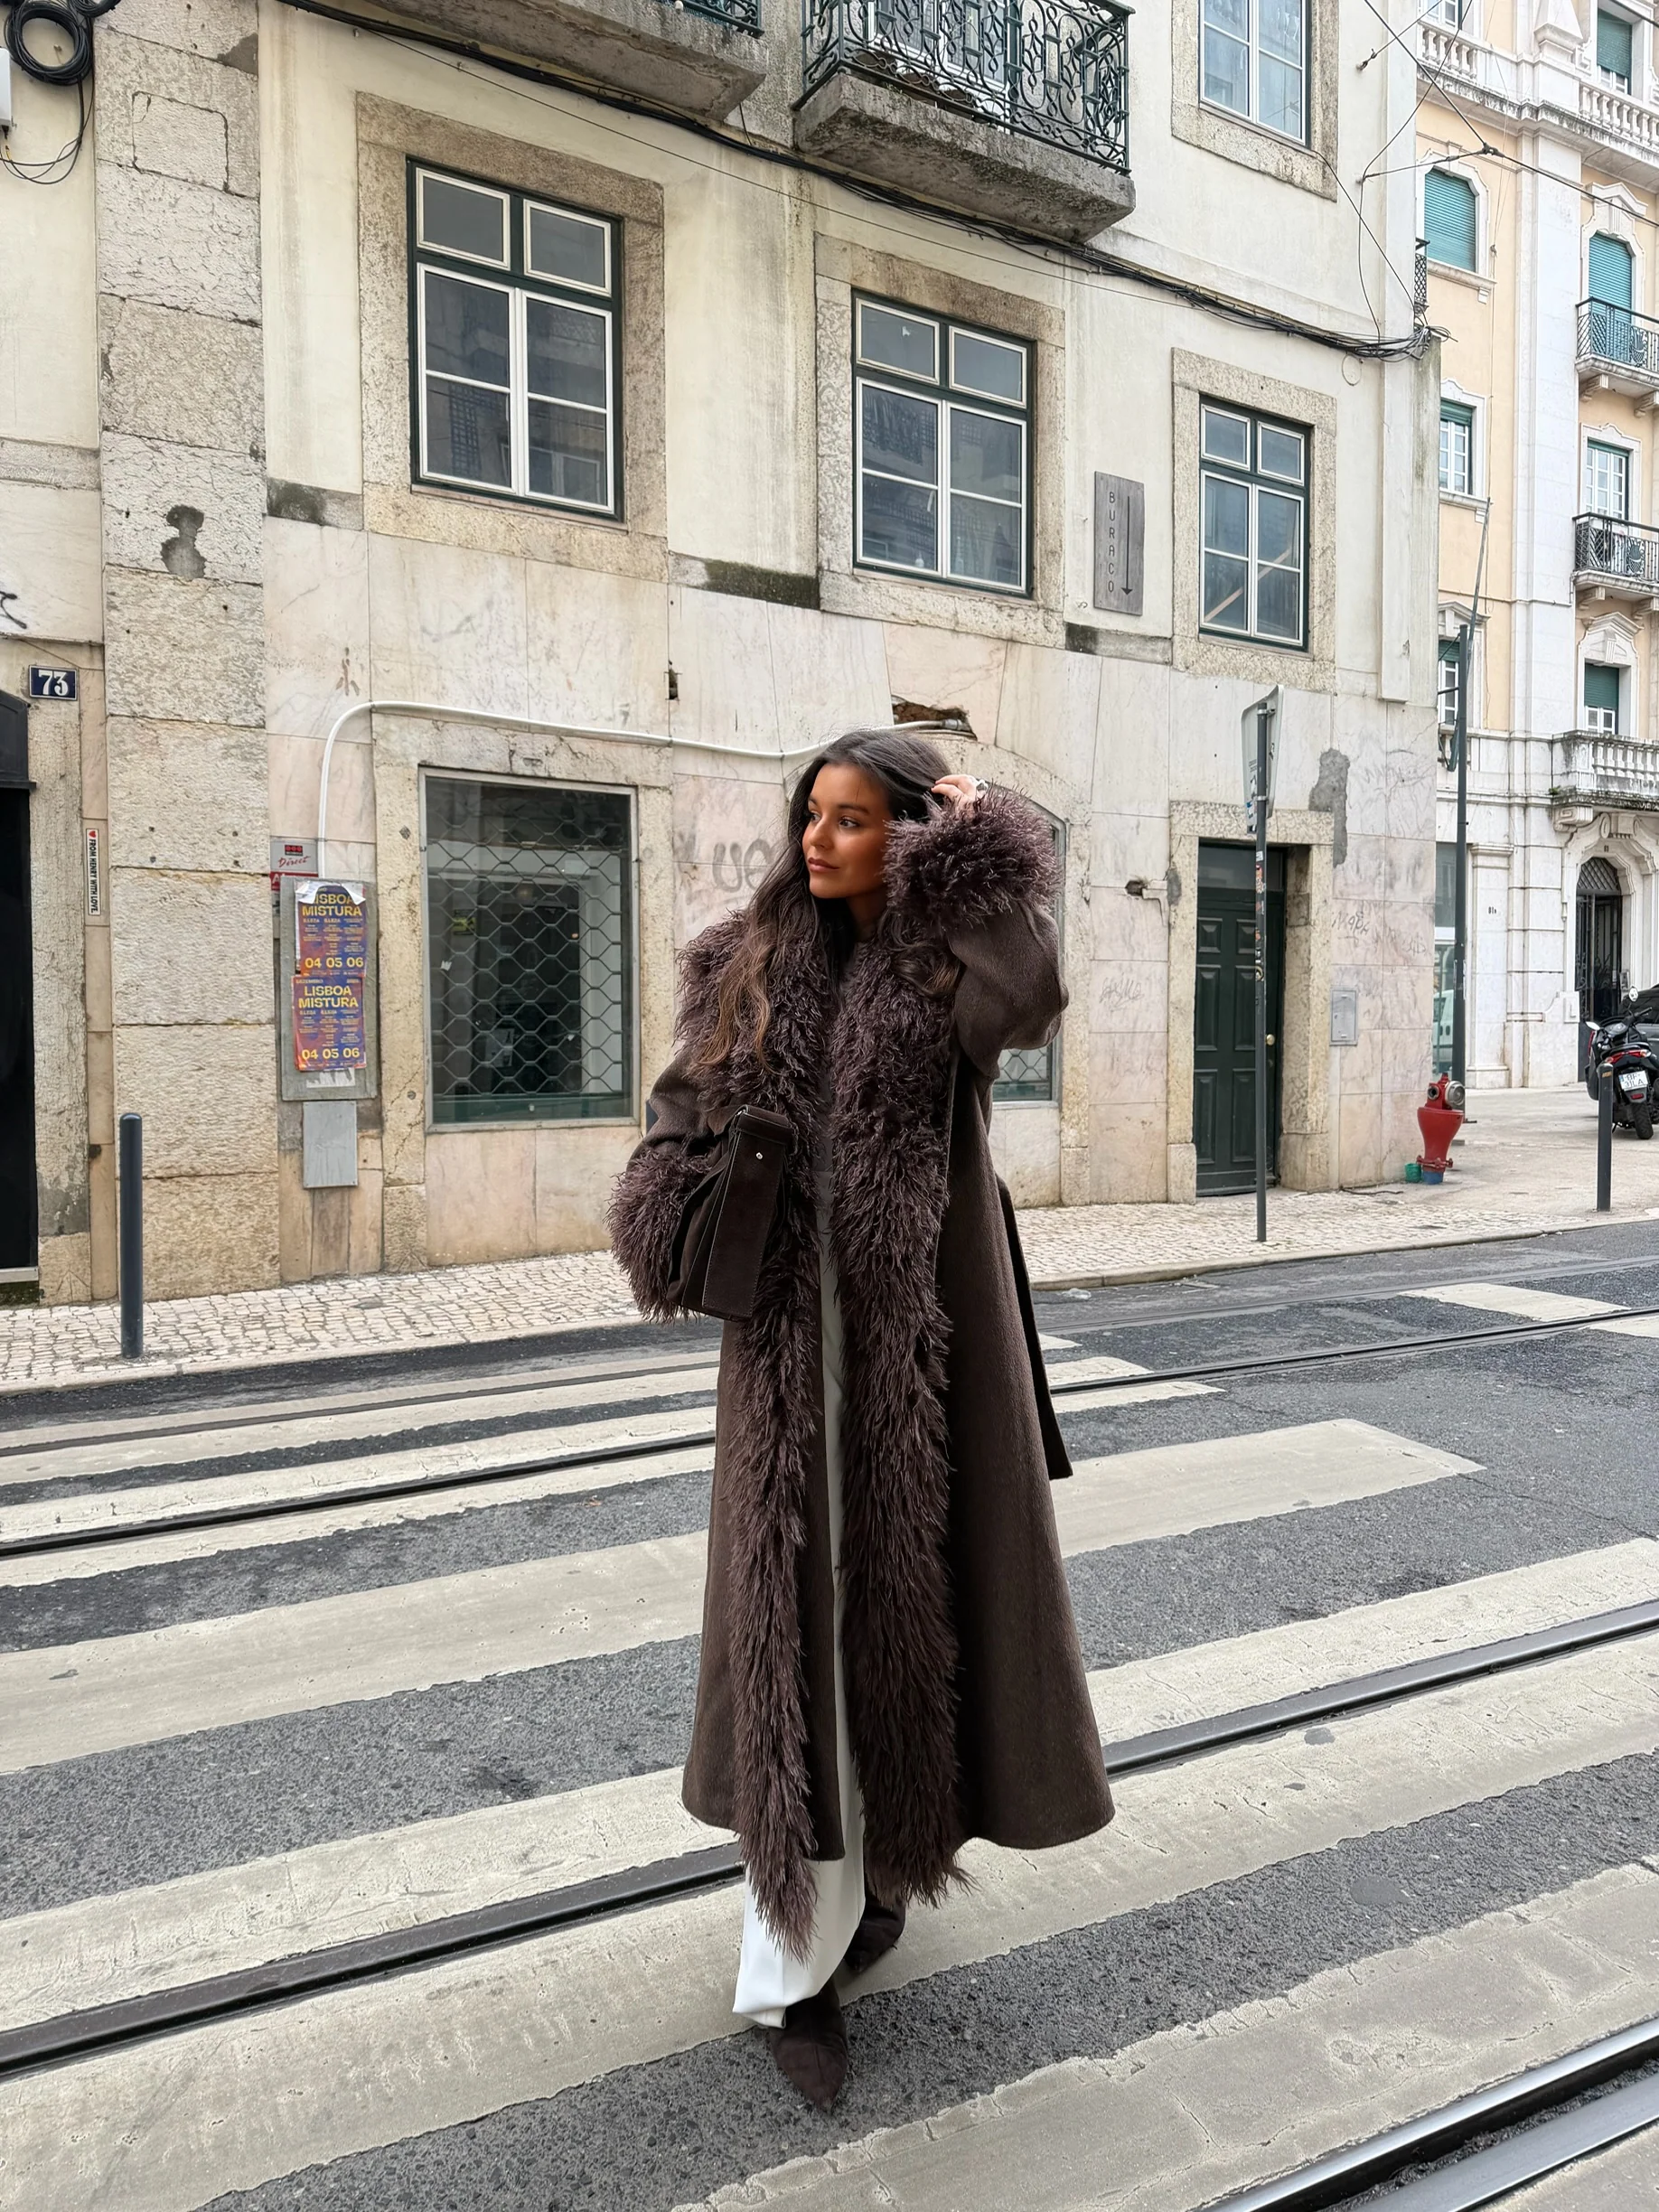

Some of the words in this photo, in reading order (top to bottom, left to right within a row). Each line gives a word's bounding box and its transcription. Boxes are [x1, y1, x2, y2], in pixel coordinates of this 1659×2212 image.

[1108, 491, 1117, 594] BURACO
[38, 669, 69, 697] 73
[89, 839, 97, 857] FROM
[89, 858, 98, 878] HENRY
[278, 855, 312, 868] Direct
[89, 878, 98, 895] WITH
[302, 905, 362, 916] MISTURA
[305, 958, 322, 969] 04
[325, 958, 342, 968] 05
[346, 957, 364, 967] 06
[305, 985, 351, 997] LISBOA
[298, 998, 359, 1008] MISTURA
[301, 1049, 318, 1060] 04
[322, 1048, 339, 1059] 05
[342, 1047, 360, 1058] 06
